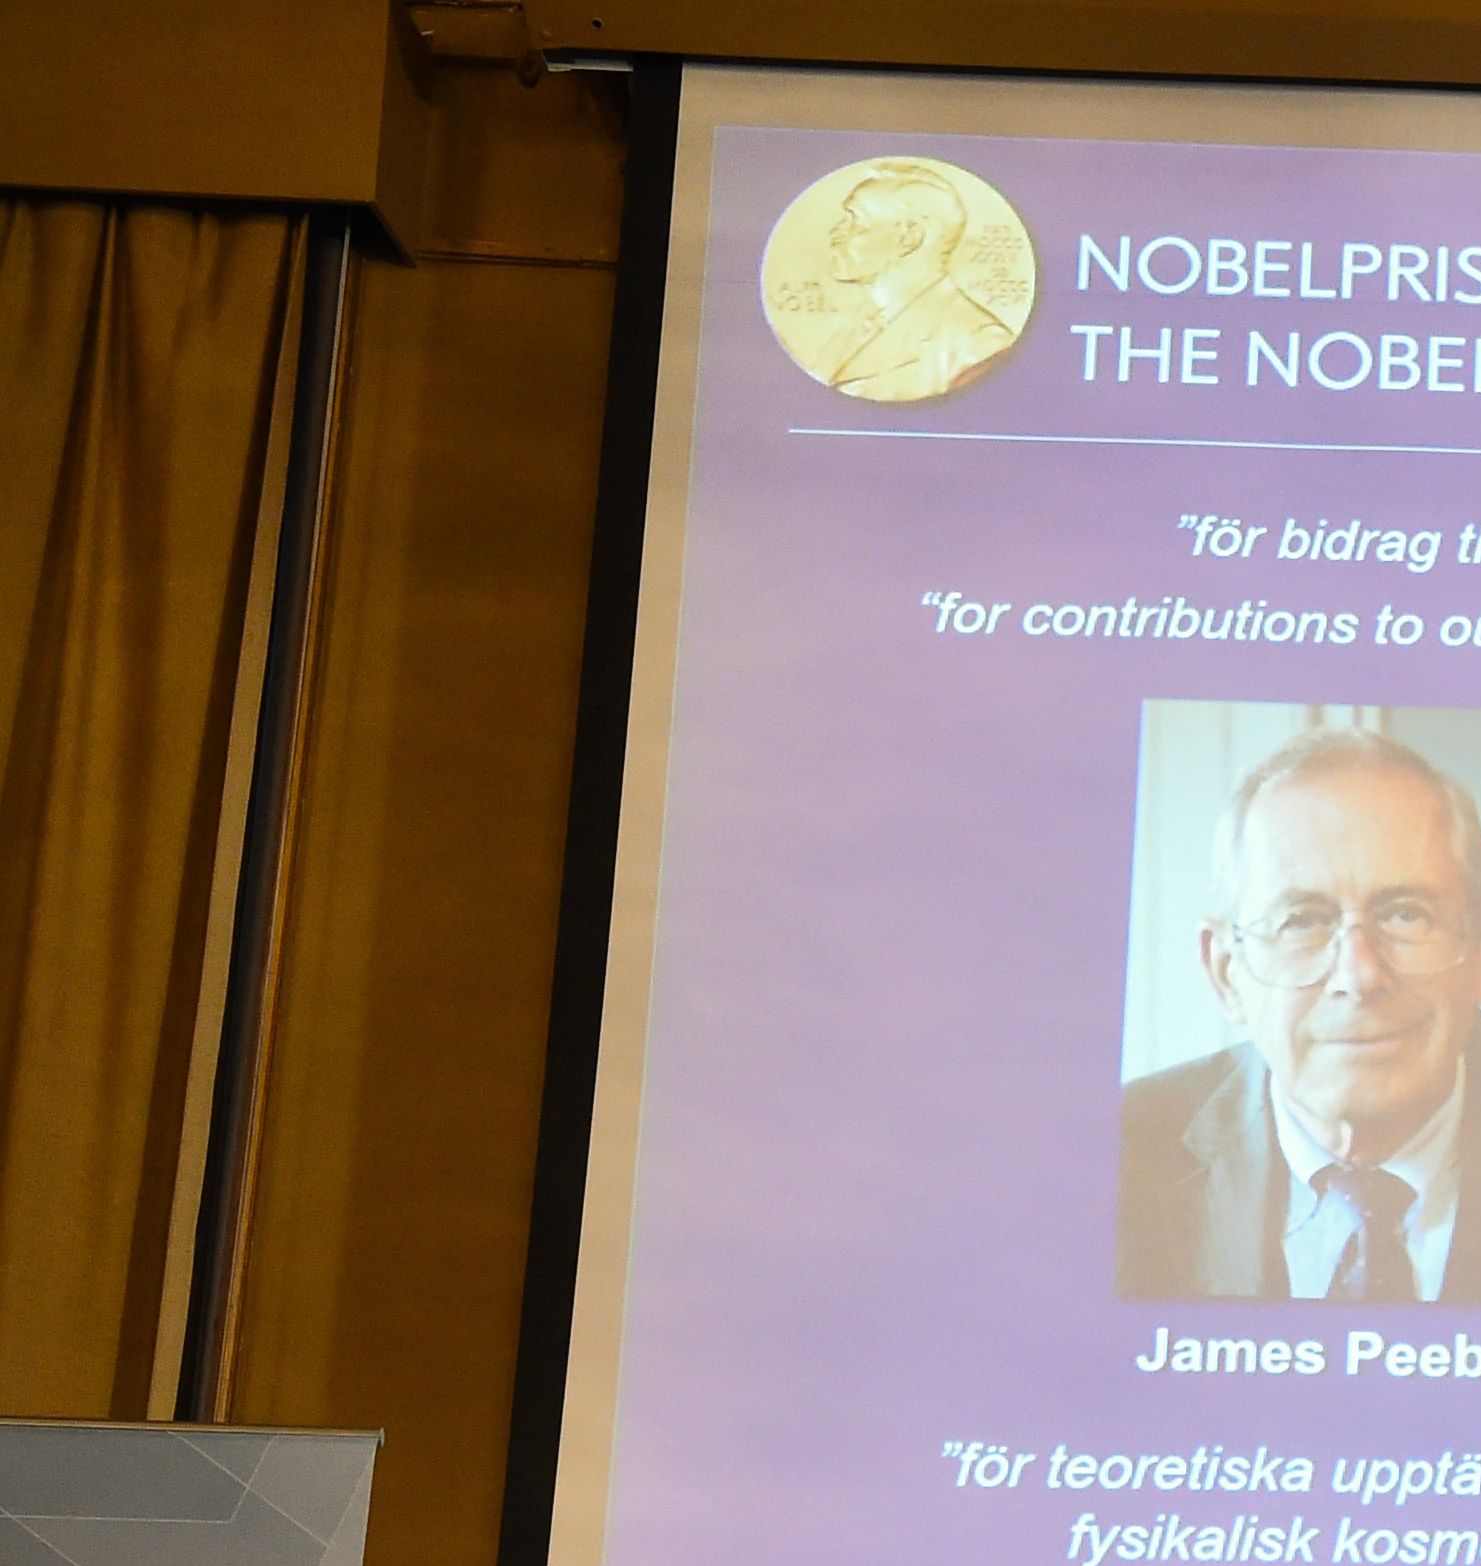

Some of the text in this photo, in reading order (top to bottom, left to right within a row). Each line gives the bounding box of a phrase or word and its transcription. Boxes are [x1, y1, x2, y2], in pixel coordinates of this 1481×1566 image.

[1069, 324, 1221, 385] THE
[1276, 517, 1443, 574] bidrag
[1022, 596, 1360, 645] contributions
[1374, 603, 1425, 646] to
[1135, 1326, 1326, 1375] James
[1046, 1444, 1315, 1493] teoretiska
